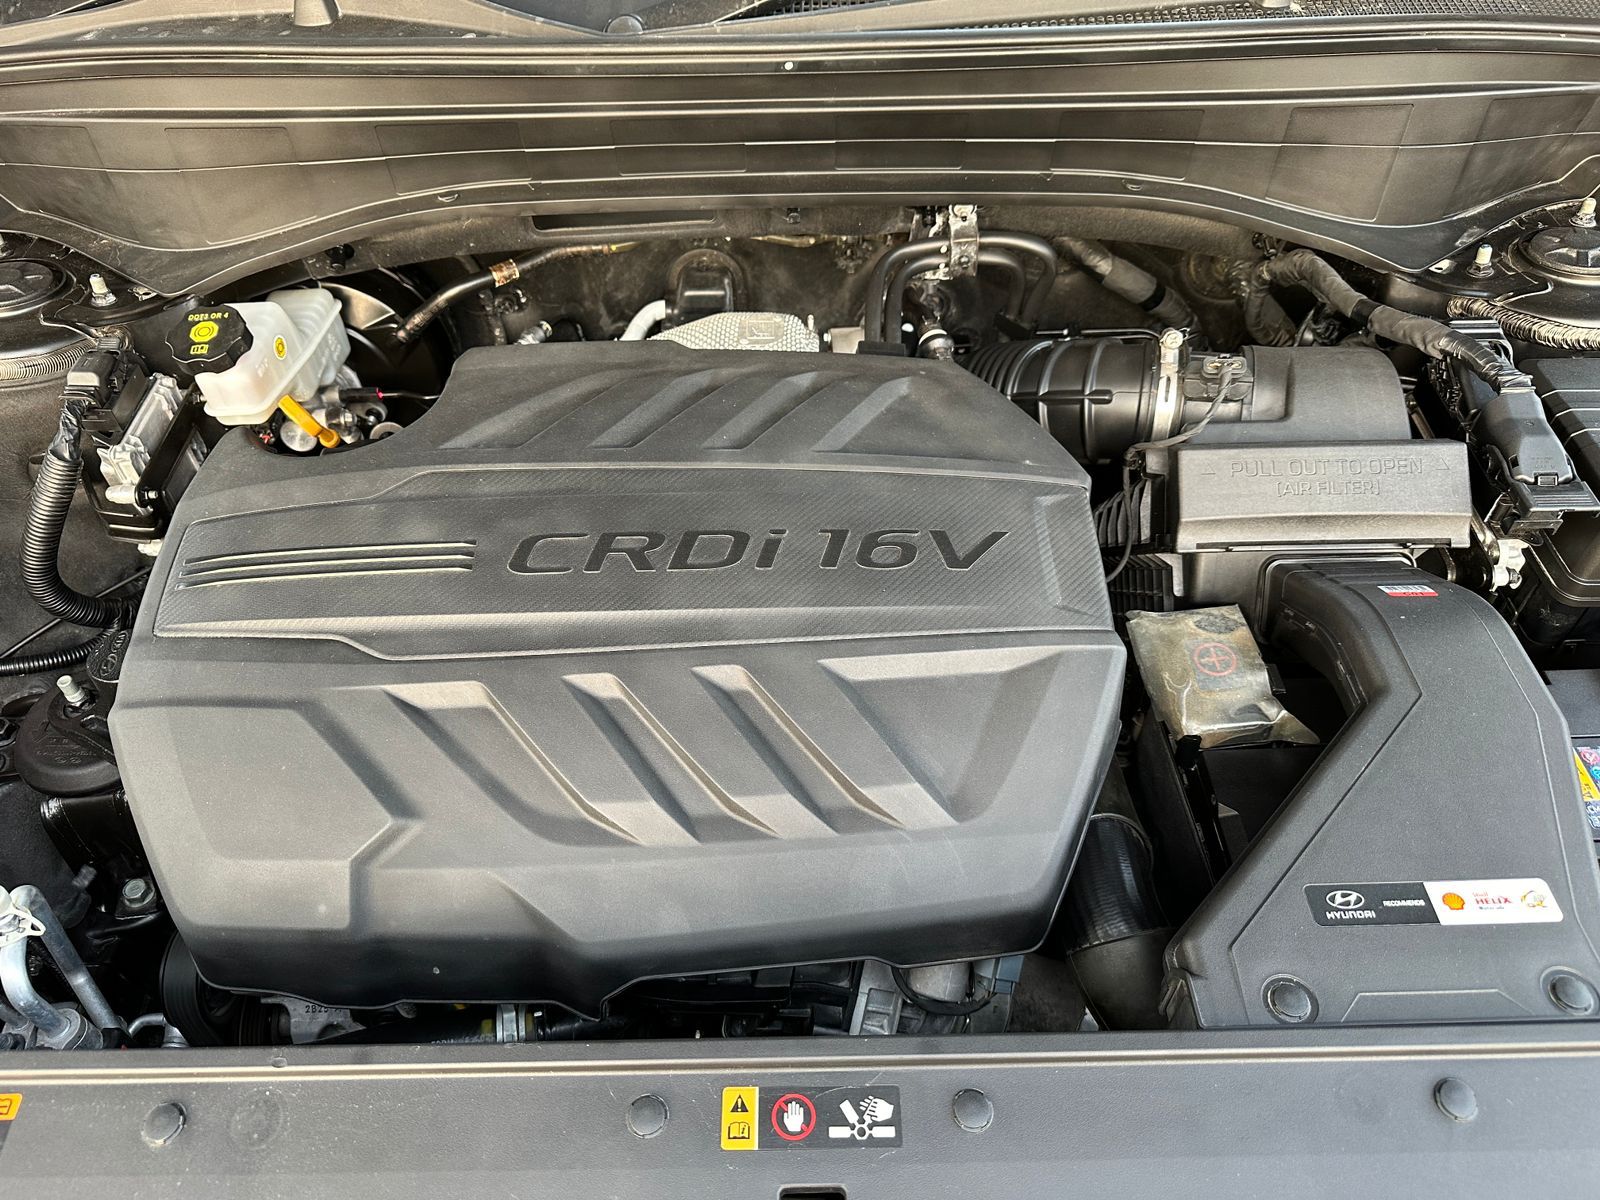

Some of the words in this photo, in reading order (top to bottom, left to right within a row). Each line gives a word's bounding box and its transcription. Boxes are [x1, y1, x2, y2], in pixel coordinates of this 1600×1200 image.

[1230, 459, 1283, 477] PULL
[1288, 458, 1330, 477] OUT
[1334, 458, 1362, 475] TO
[1369, 457, 1423, 475] OPEN
[507, 528, 789, 576] CRDi
[819, 528, 1010, 572] 16V
[1475, 895, 1512, 905] HELIX
[1326, 910, 1376, 920] HYUNDAI
